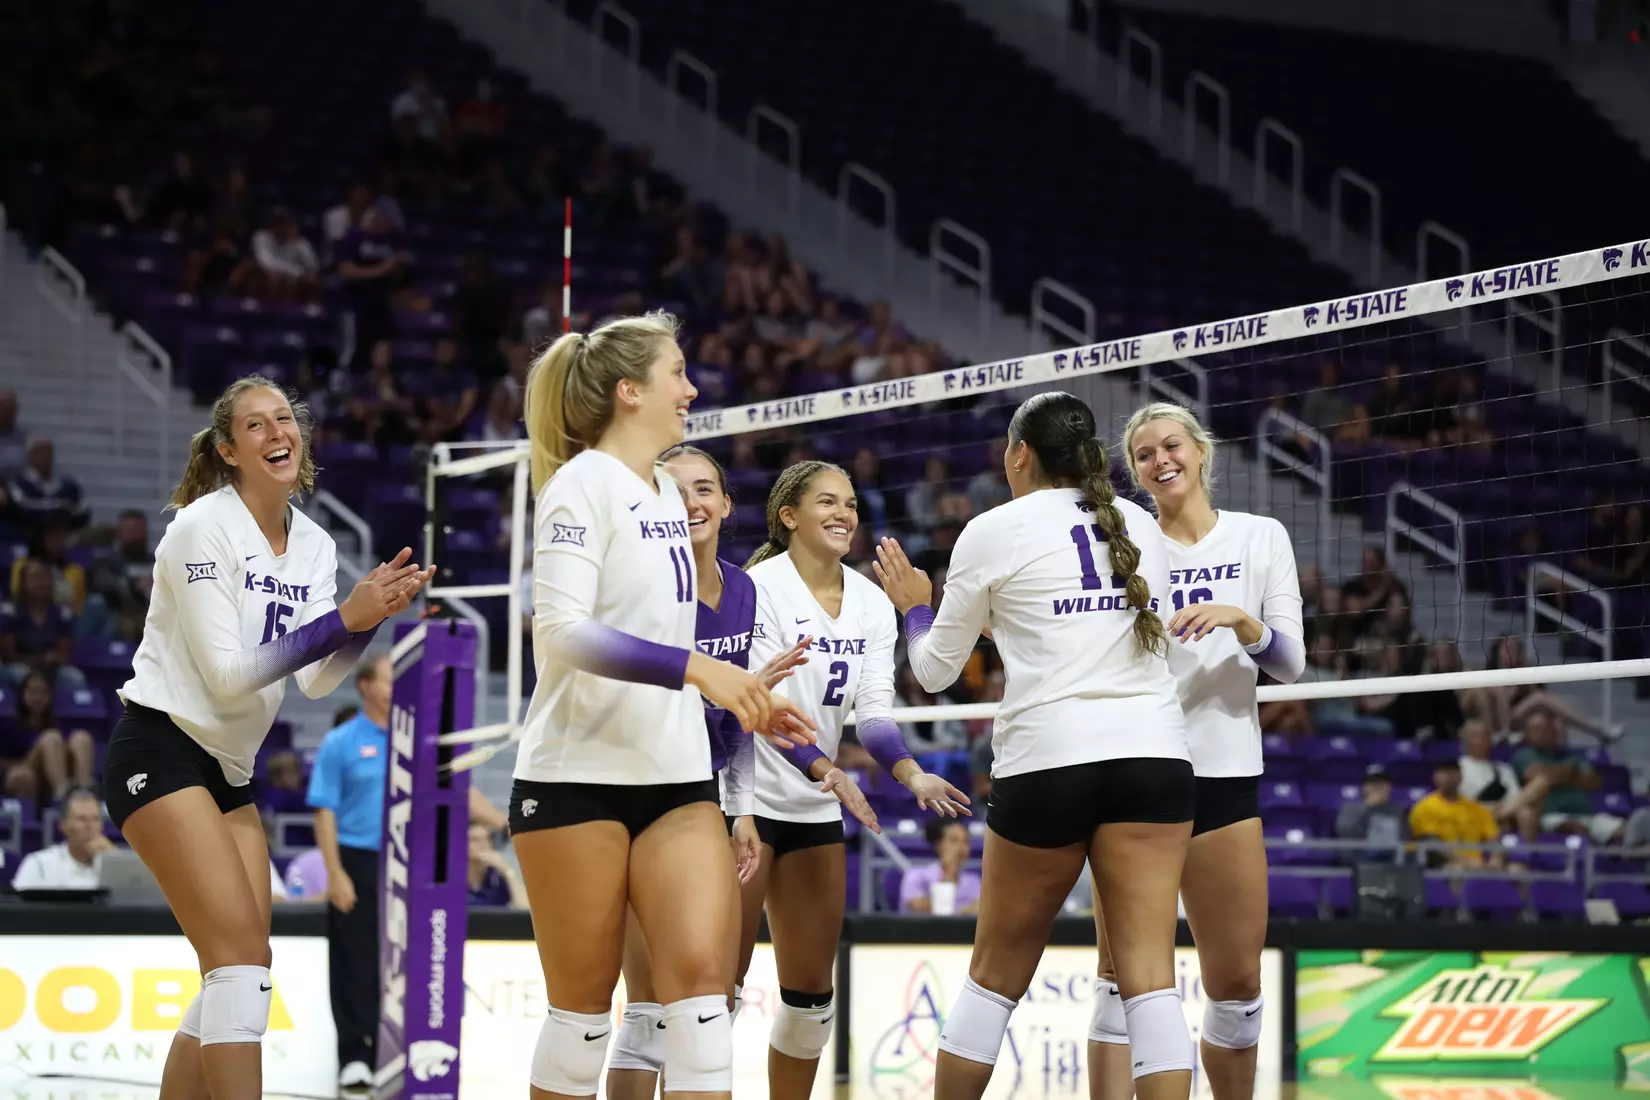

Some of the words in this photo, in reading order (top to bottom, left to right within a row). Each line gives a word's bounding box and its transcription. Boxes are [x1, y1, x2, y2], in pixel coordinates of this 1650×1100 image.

[1471, 258, 1560, 297] K-STATE
[1326, 288, 1408, 325] K-STATE
[1194, 315, 1269, 349] K-STATE
[1072, 339, 1141, 370] K-STATE
[961, 360, 1024, 389] K-STATE
[762, 398, 816, 422] K-STATE
[859, 380, 916, 406] K-STATE
[669, 545, 693, 603] 11
[259, 600, 295, 645] 15
[1053, 595, 1160, 616] WILDCS
[822, 660, 849, 707] 2
[384, 704, 416, 1028] K-STATE
